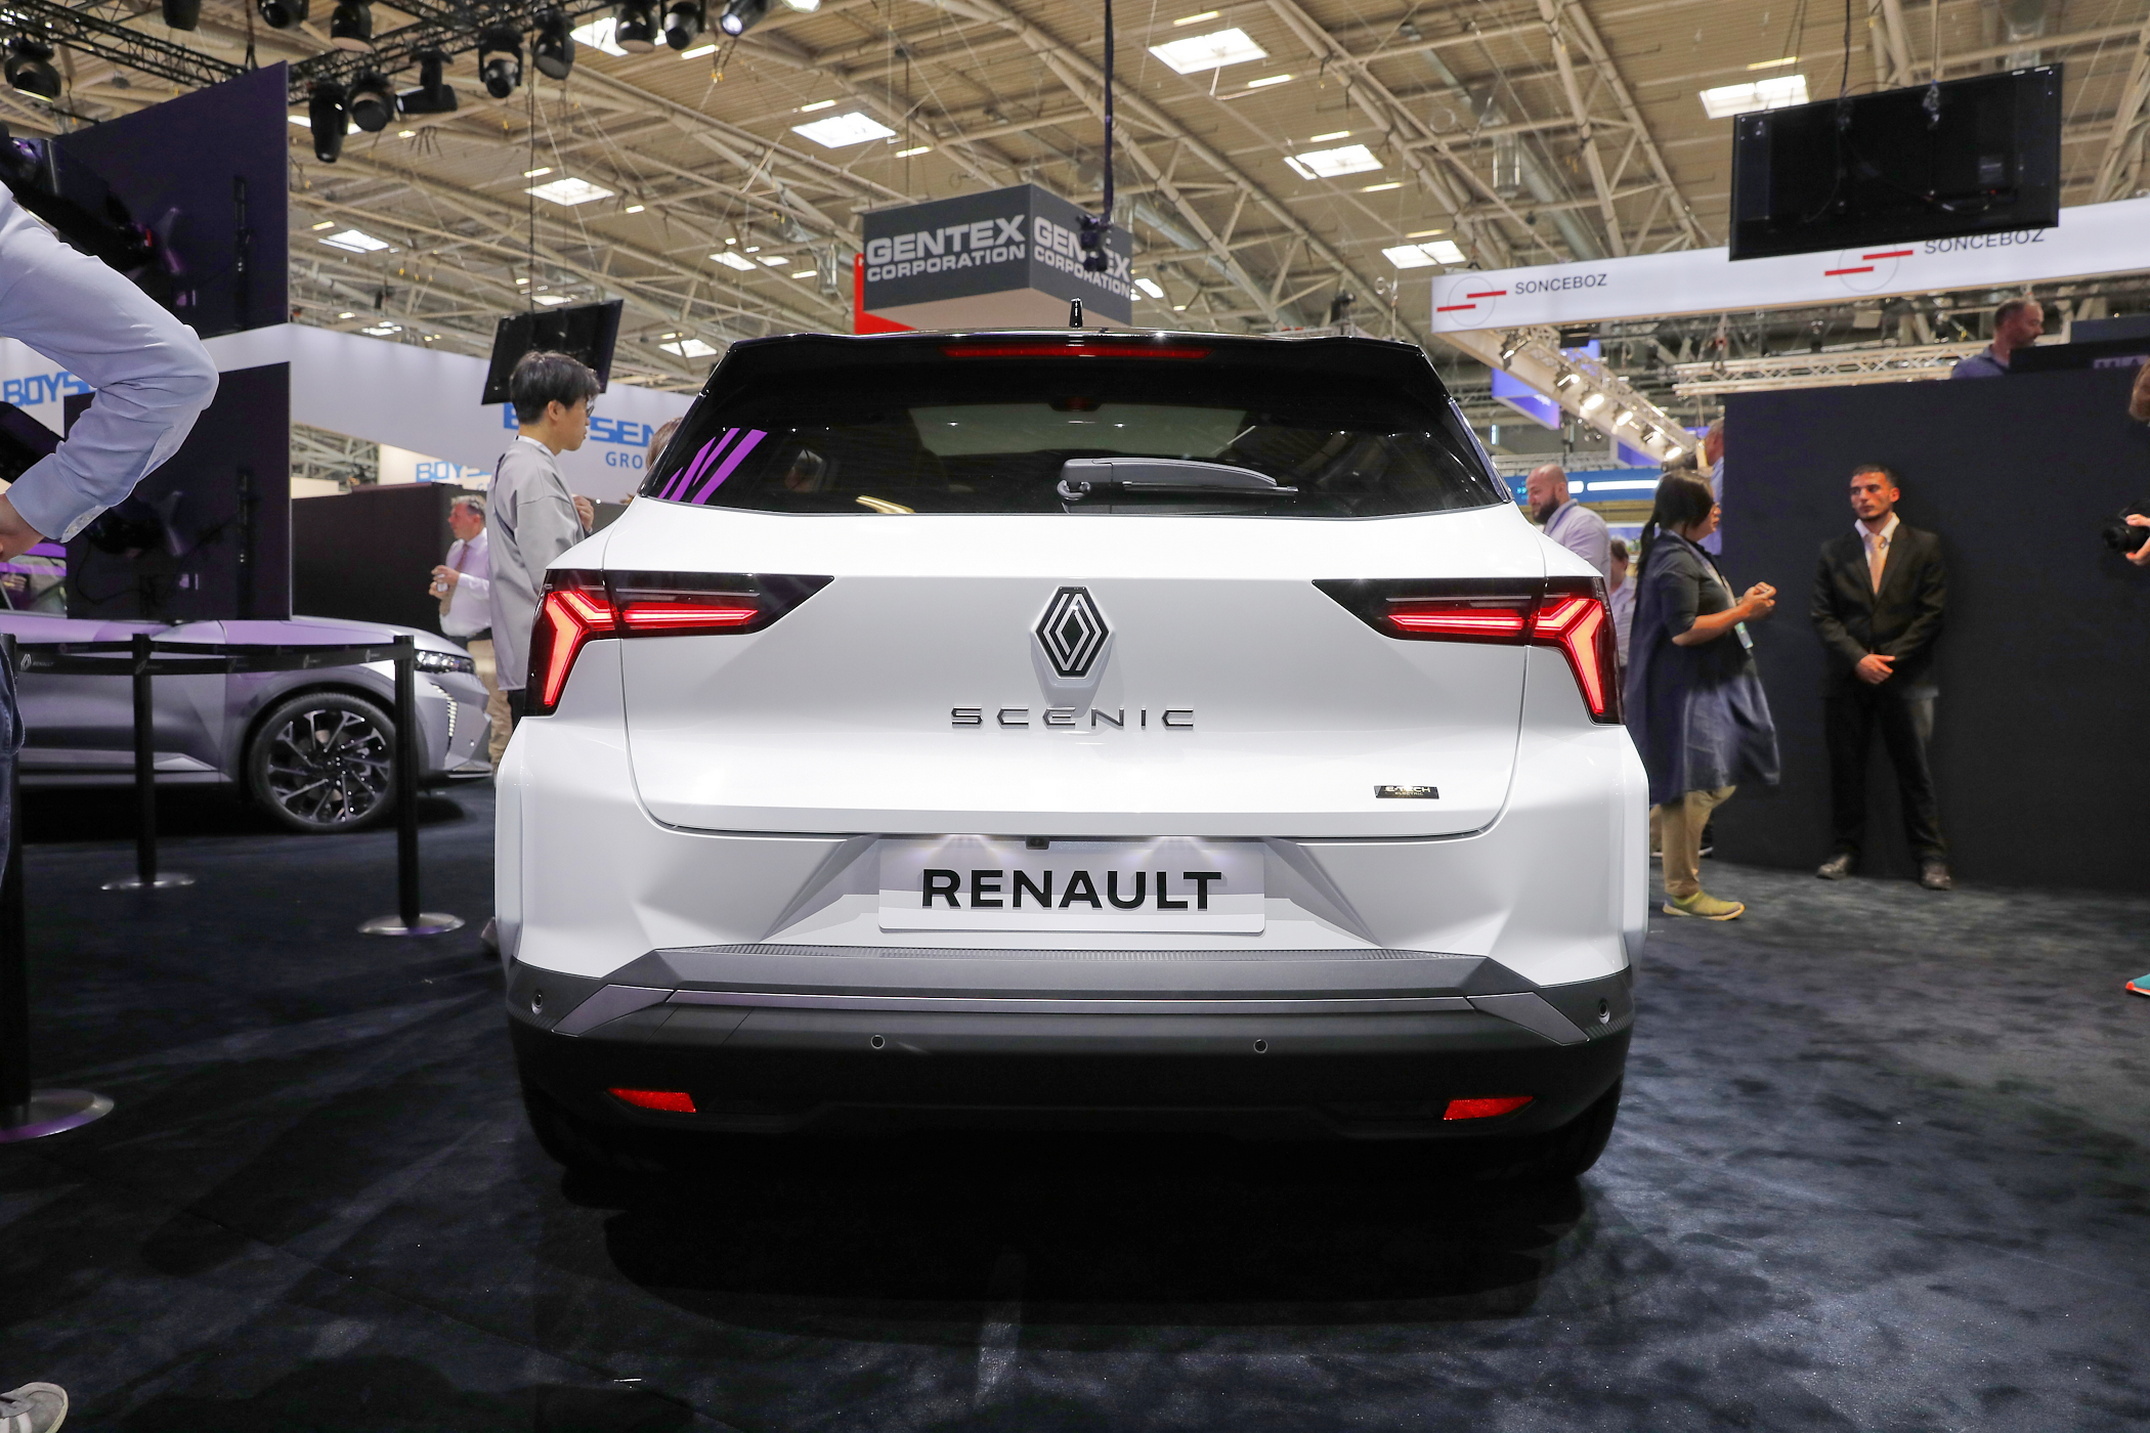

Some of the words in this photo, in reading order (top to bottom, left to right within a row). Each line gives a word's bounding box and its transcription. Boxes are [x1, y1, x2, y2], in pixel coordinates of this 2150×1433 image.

[866, 214, 1026, 266] GENTEX
[1034, 216, 1130, 283] GENEX
[1925, 228, 2045, 254] SONCEBOZ
[866, 244, 1026, 282] CORPORATION
[1515, 273, 1607, 295] SONCEBOZ
[605, 451, 643, 469] GRO
[951, 706, 1195, 728] SCENIC
[922, 868, 1222, 911] RENAULT
